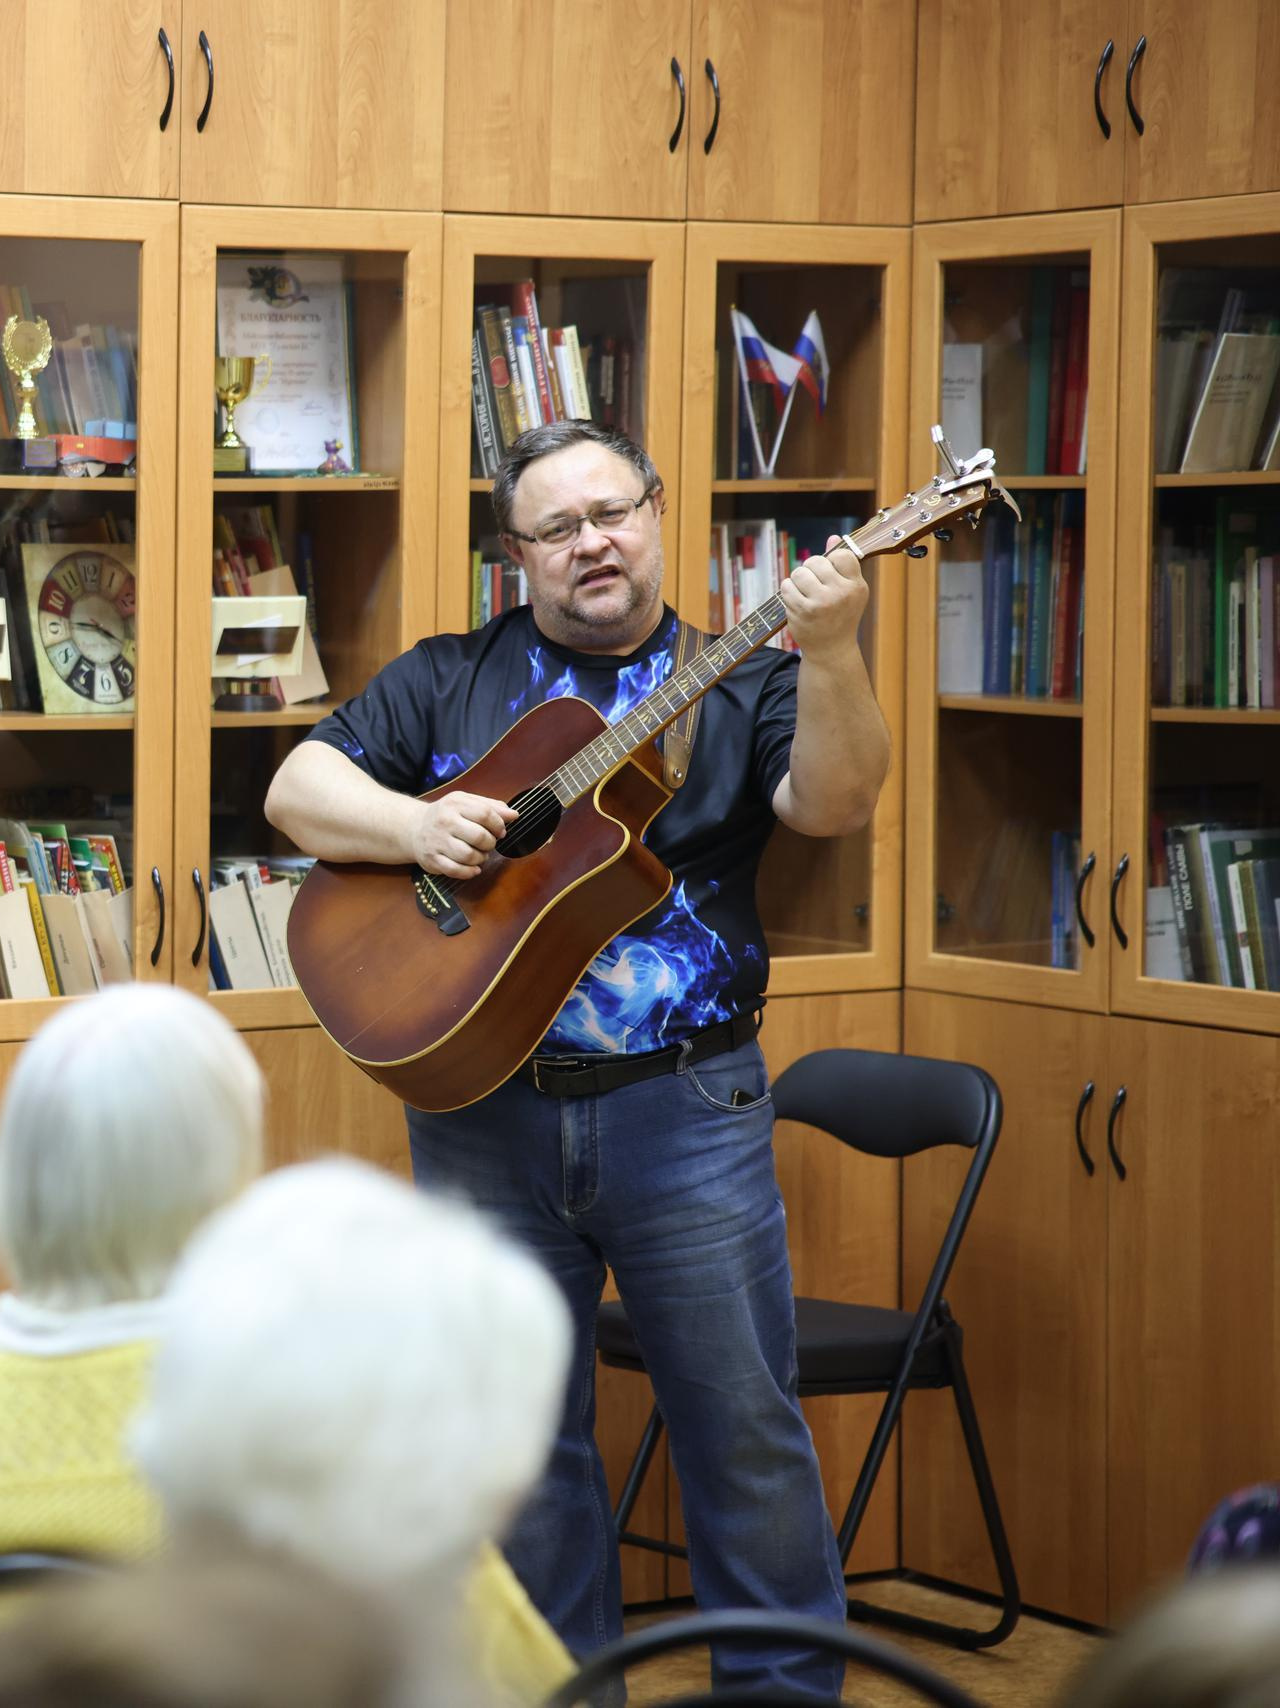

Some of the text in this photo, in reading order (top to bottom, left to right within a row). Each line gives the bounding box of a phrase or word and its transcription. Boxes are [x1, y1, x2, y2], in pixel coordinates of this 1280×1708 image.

[477, 402, 493, 448] ИСТОРИЯ
[62, 570, 79, 590] 11
[82, 563, 99, 584] 12
[107, 571, 116, 588] 1
[48, 590, 66, 610] 10
[47, 621, 62, 635] 9
[57, 647, 74, 665] 8
[78, 662, 91, 685] 7
[100, 669, 112, 692] 6
